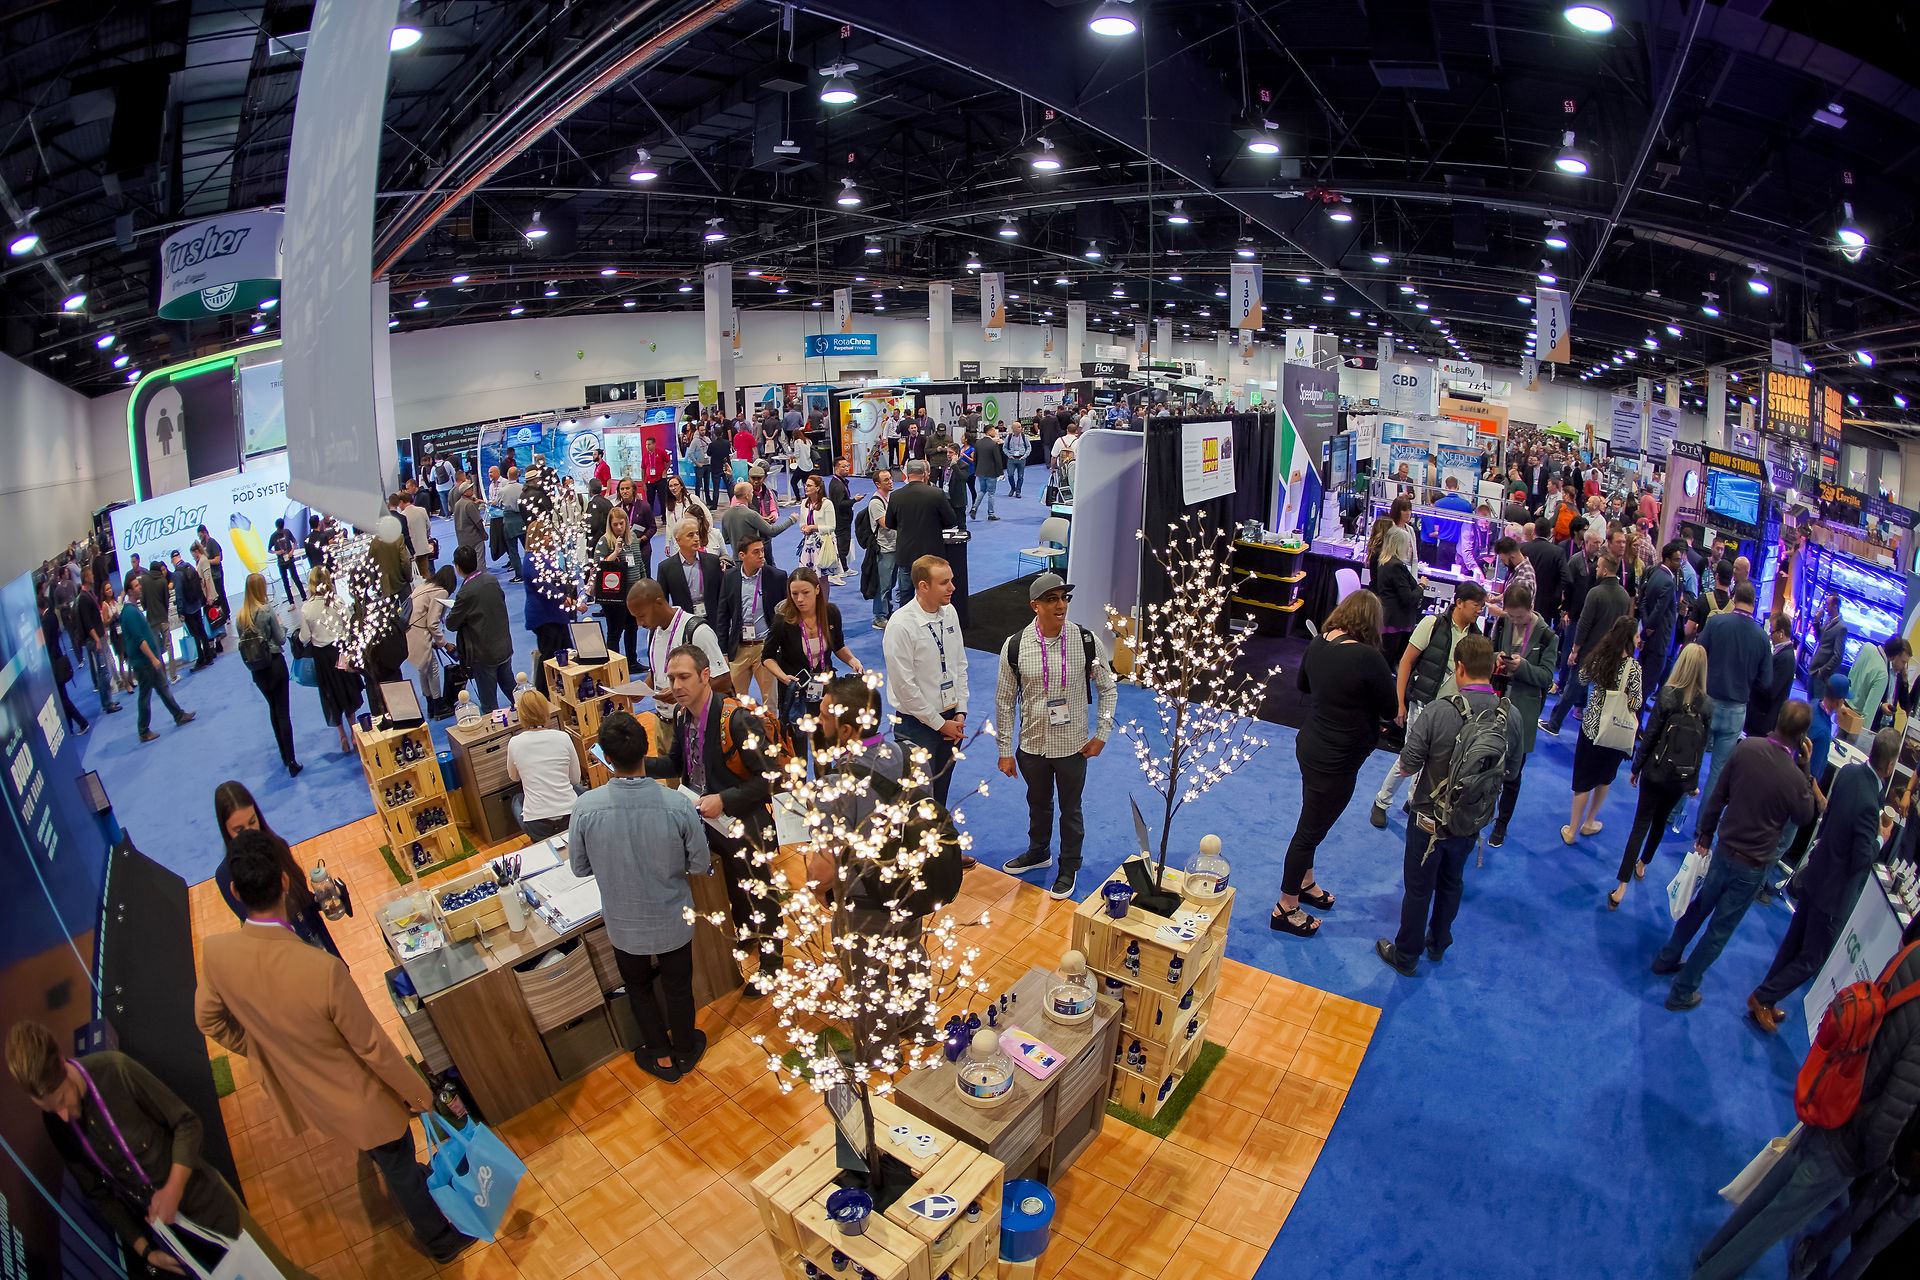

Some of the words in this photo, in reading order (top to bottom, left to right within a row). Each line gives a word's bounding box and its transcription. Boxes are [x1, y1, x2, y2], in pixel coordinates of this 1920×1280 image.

[1549, 307, 1557, 350] 1400
[833, 337, 871, 345] RotaChrom
[1450, 365, 1475, 377] Leafly
[1392, 374, 1418, 387] CBD
[1768, 372, 1811, 400] GROW
[1768, 393, 1810, 418] STRONG
[1393, 445, 1427, 456] NEEDLES
[1441, 451, 1478, 463] NEEDLES
[1709, 451, 1730, 467] GROW
[1774, 467, 1793, 481] LOTUS
[232, 490, 255, 505] POD
[123, 504, 208, 551] iKrusher
[1844, 927, 1861, 965] ICG
[12, 1224, 27, 1268] PRICE
